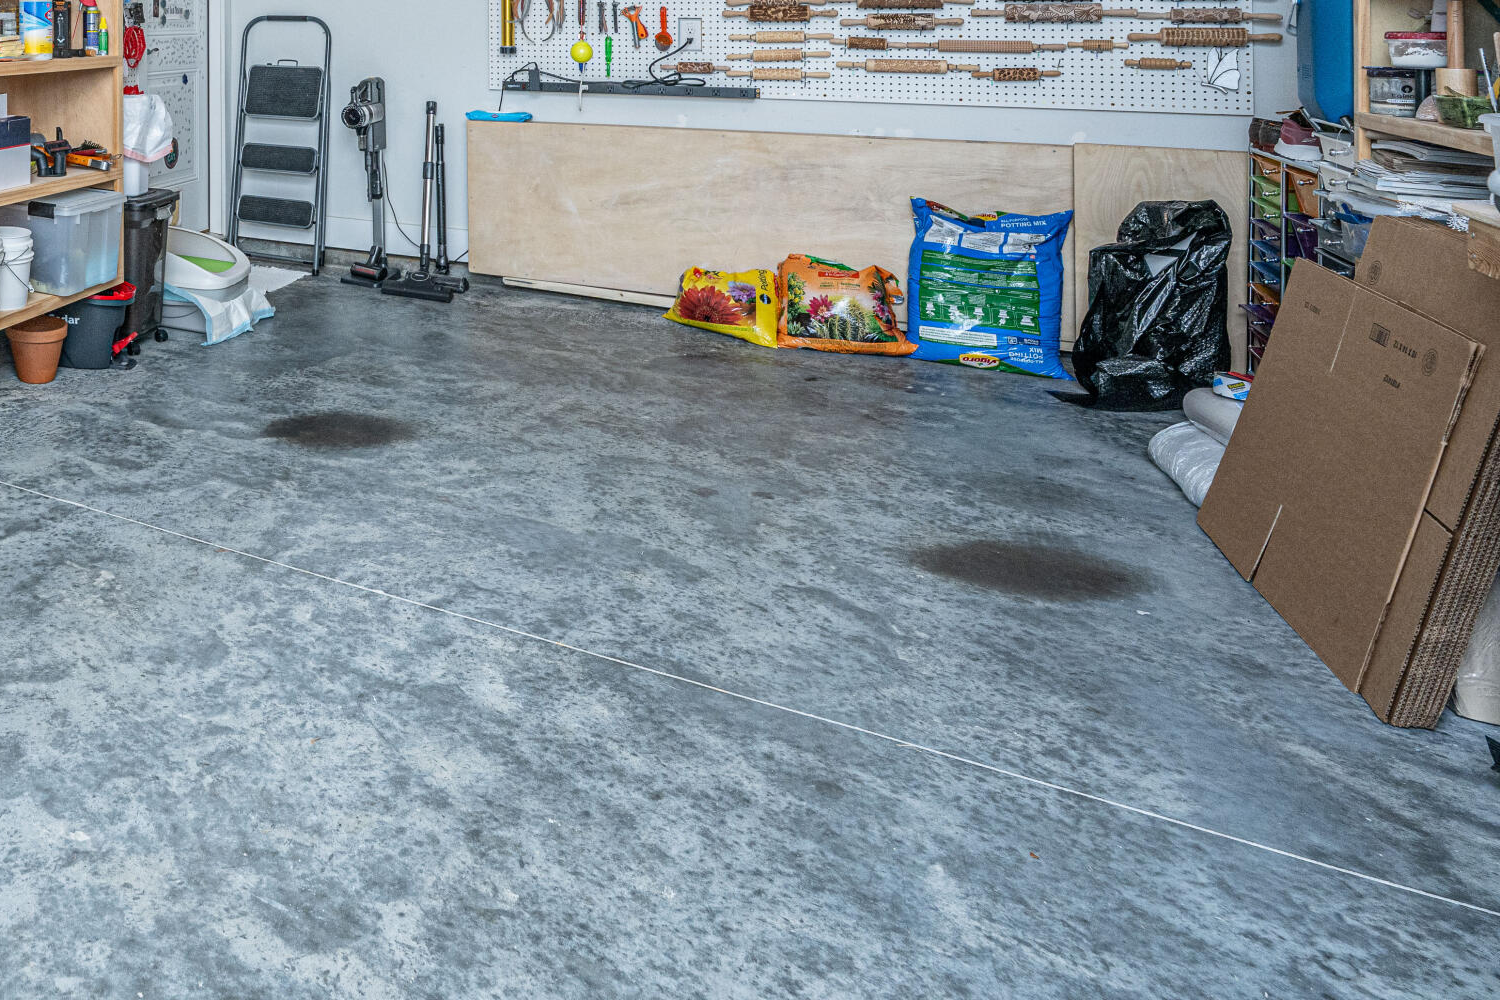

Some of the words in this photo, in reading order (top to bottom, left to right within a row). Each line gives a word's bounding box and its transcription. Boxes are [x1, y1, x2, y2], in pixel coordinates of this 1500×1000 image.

[760, 268, 768, 292] Potting
[1008, 351, 1044, 360] POTTING
[961, 356, 997, 366] Vigoro
